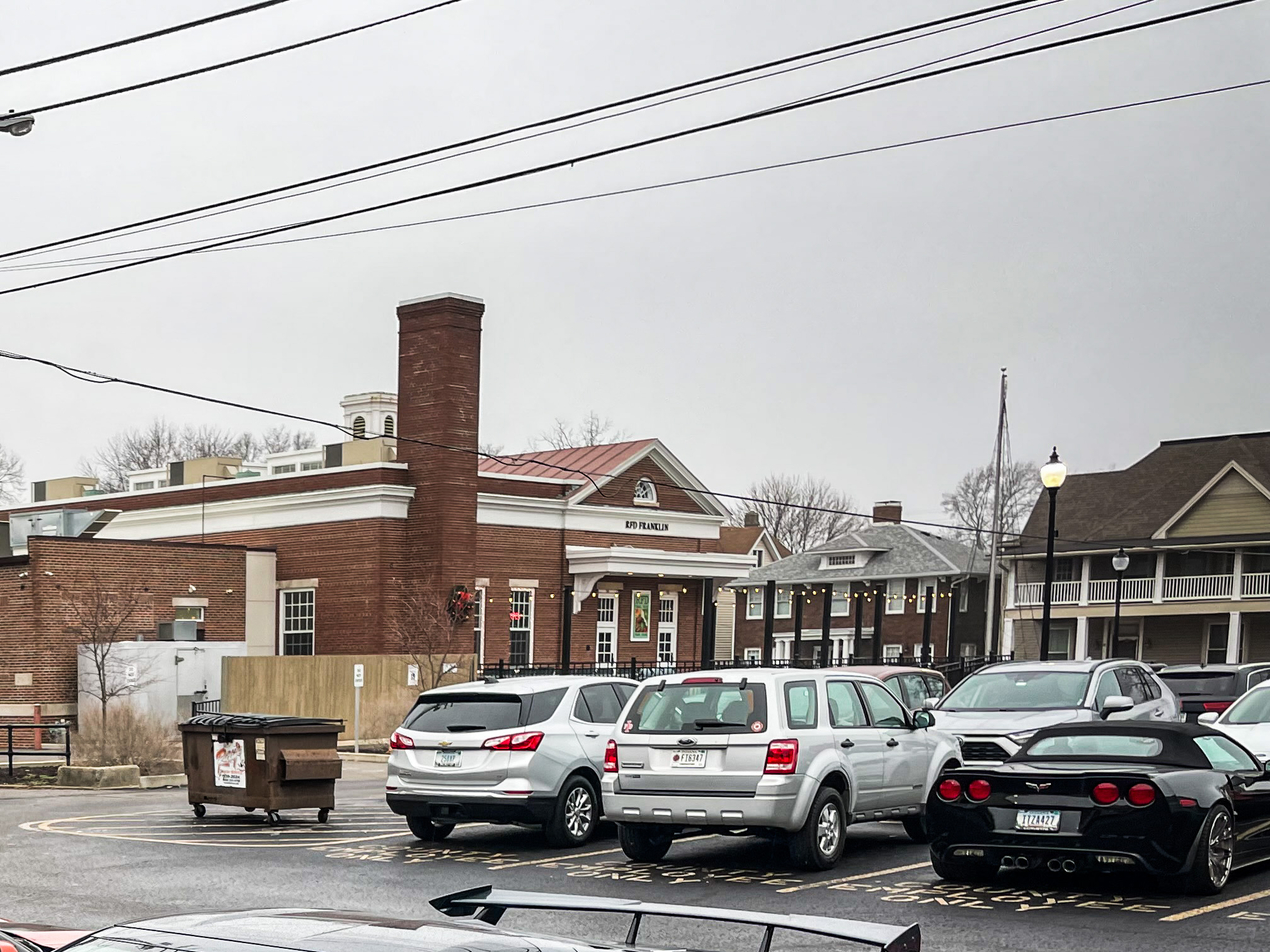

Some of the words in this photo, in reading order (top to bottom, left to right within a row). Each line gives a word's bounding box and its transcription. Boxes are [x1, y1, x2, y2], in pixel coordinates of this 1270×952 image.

[625, 521, 637, 530] RFD
[639, 521, 669, 531] FRANKLIN
[827, 882, 1171, 913] EMPLOYEE
[880, 894, 1053, 912] ONLY
